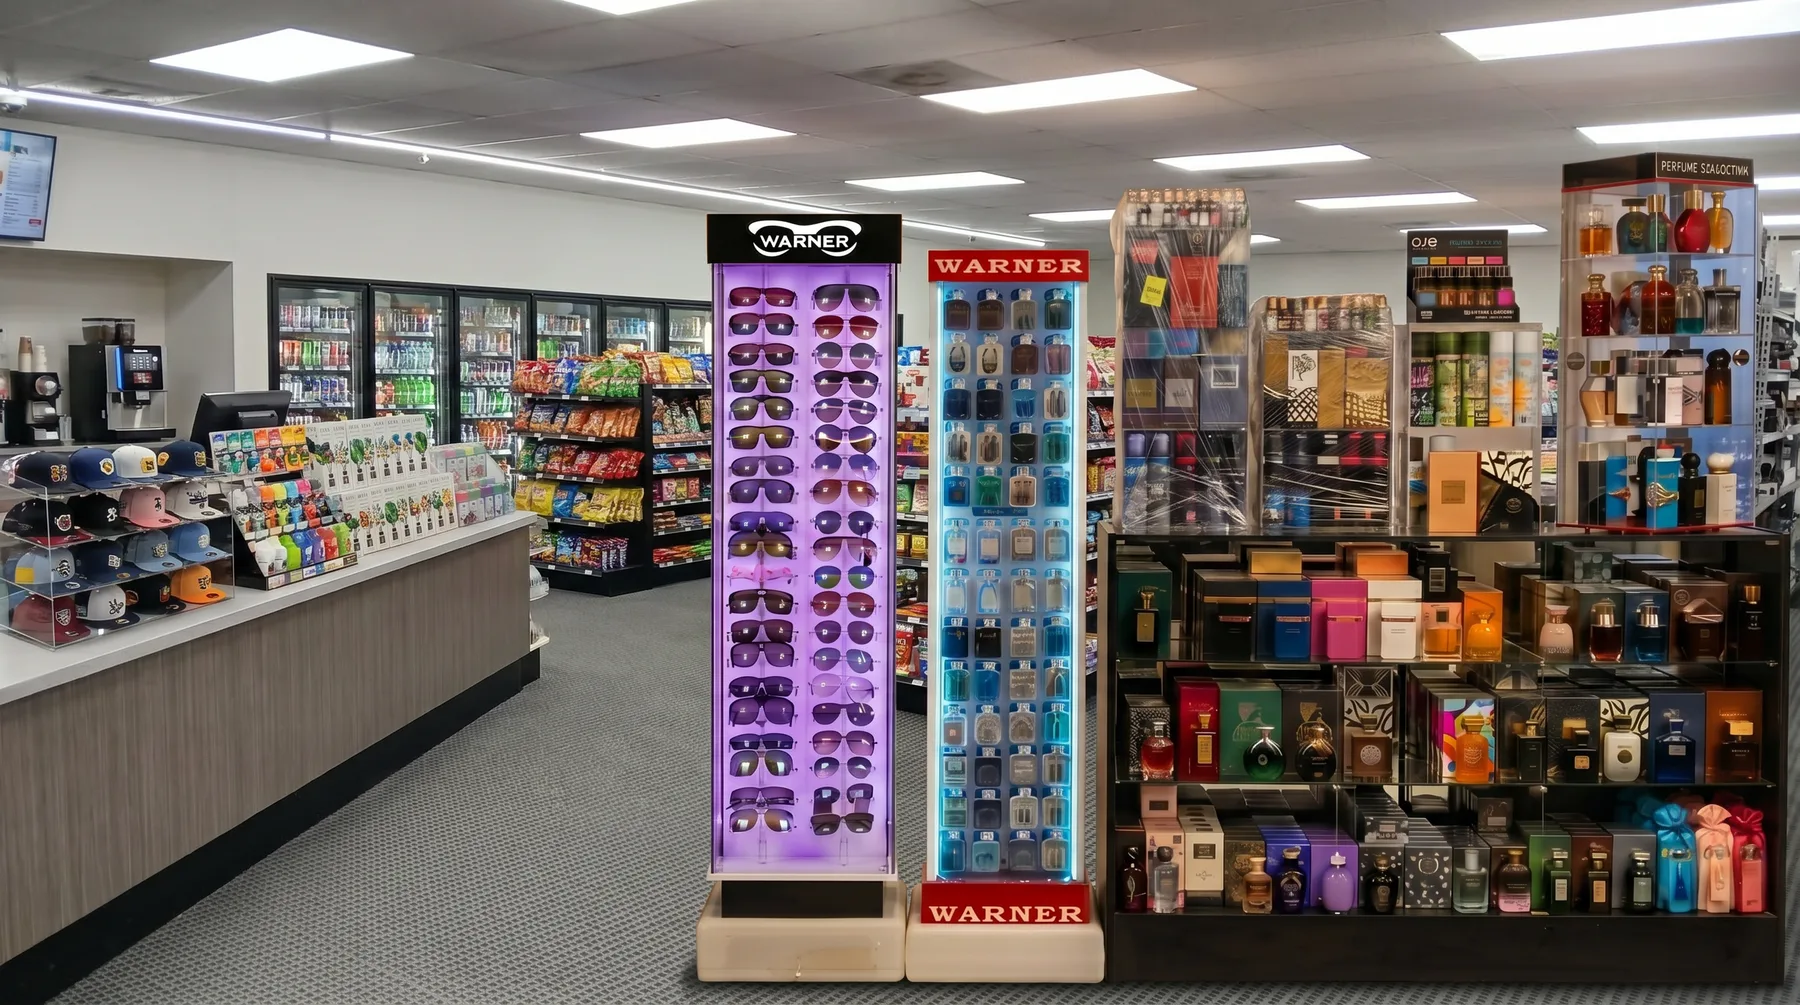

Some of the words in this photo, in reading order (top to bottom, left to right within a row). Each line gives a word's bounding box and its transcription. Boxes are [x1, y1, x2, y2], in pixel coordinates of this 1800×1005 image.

[1661, 160, 1698, 173] PERFUME
[760, 235, 849, 248] WARNER
[934, 258, 1083, 274] WARNER
[928, 905, 1083, 922] WARNER
